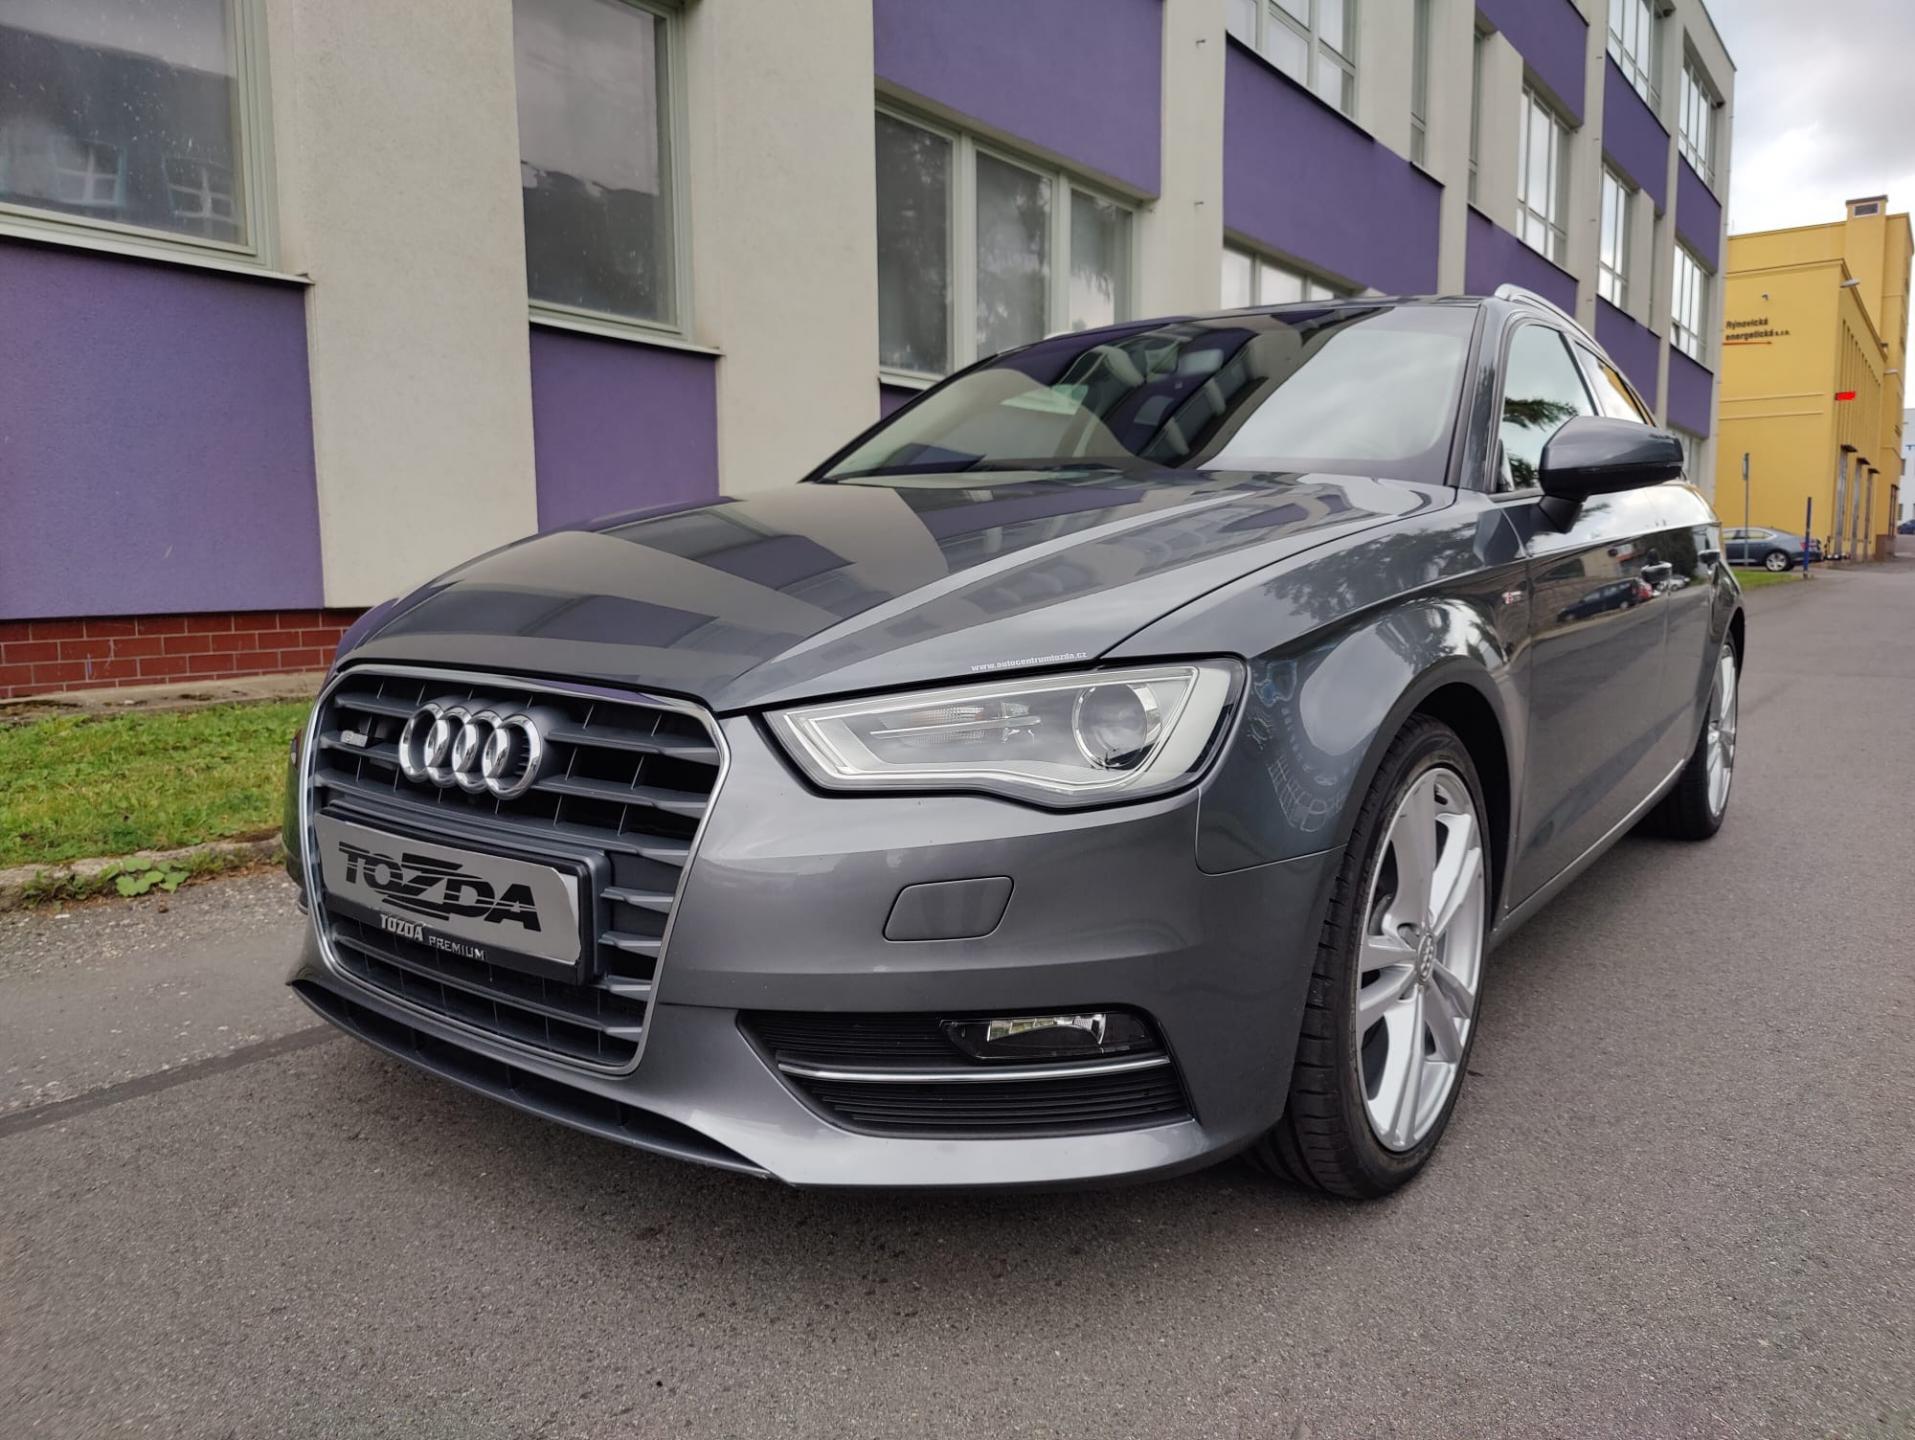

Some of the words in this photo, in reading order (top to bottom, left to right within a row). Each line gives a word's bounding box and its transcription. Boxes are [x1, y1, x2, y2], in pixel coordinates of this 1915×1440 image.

[338, 841, 541, 932] TOZDA
[380, 913, 424, 941] TOZDA
[428, 935, 486, 960] PREMIUM
